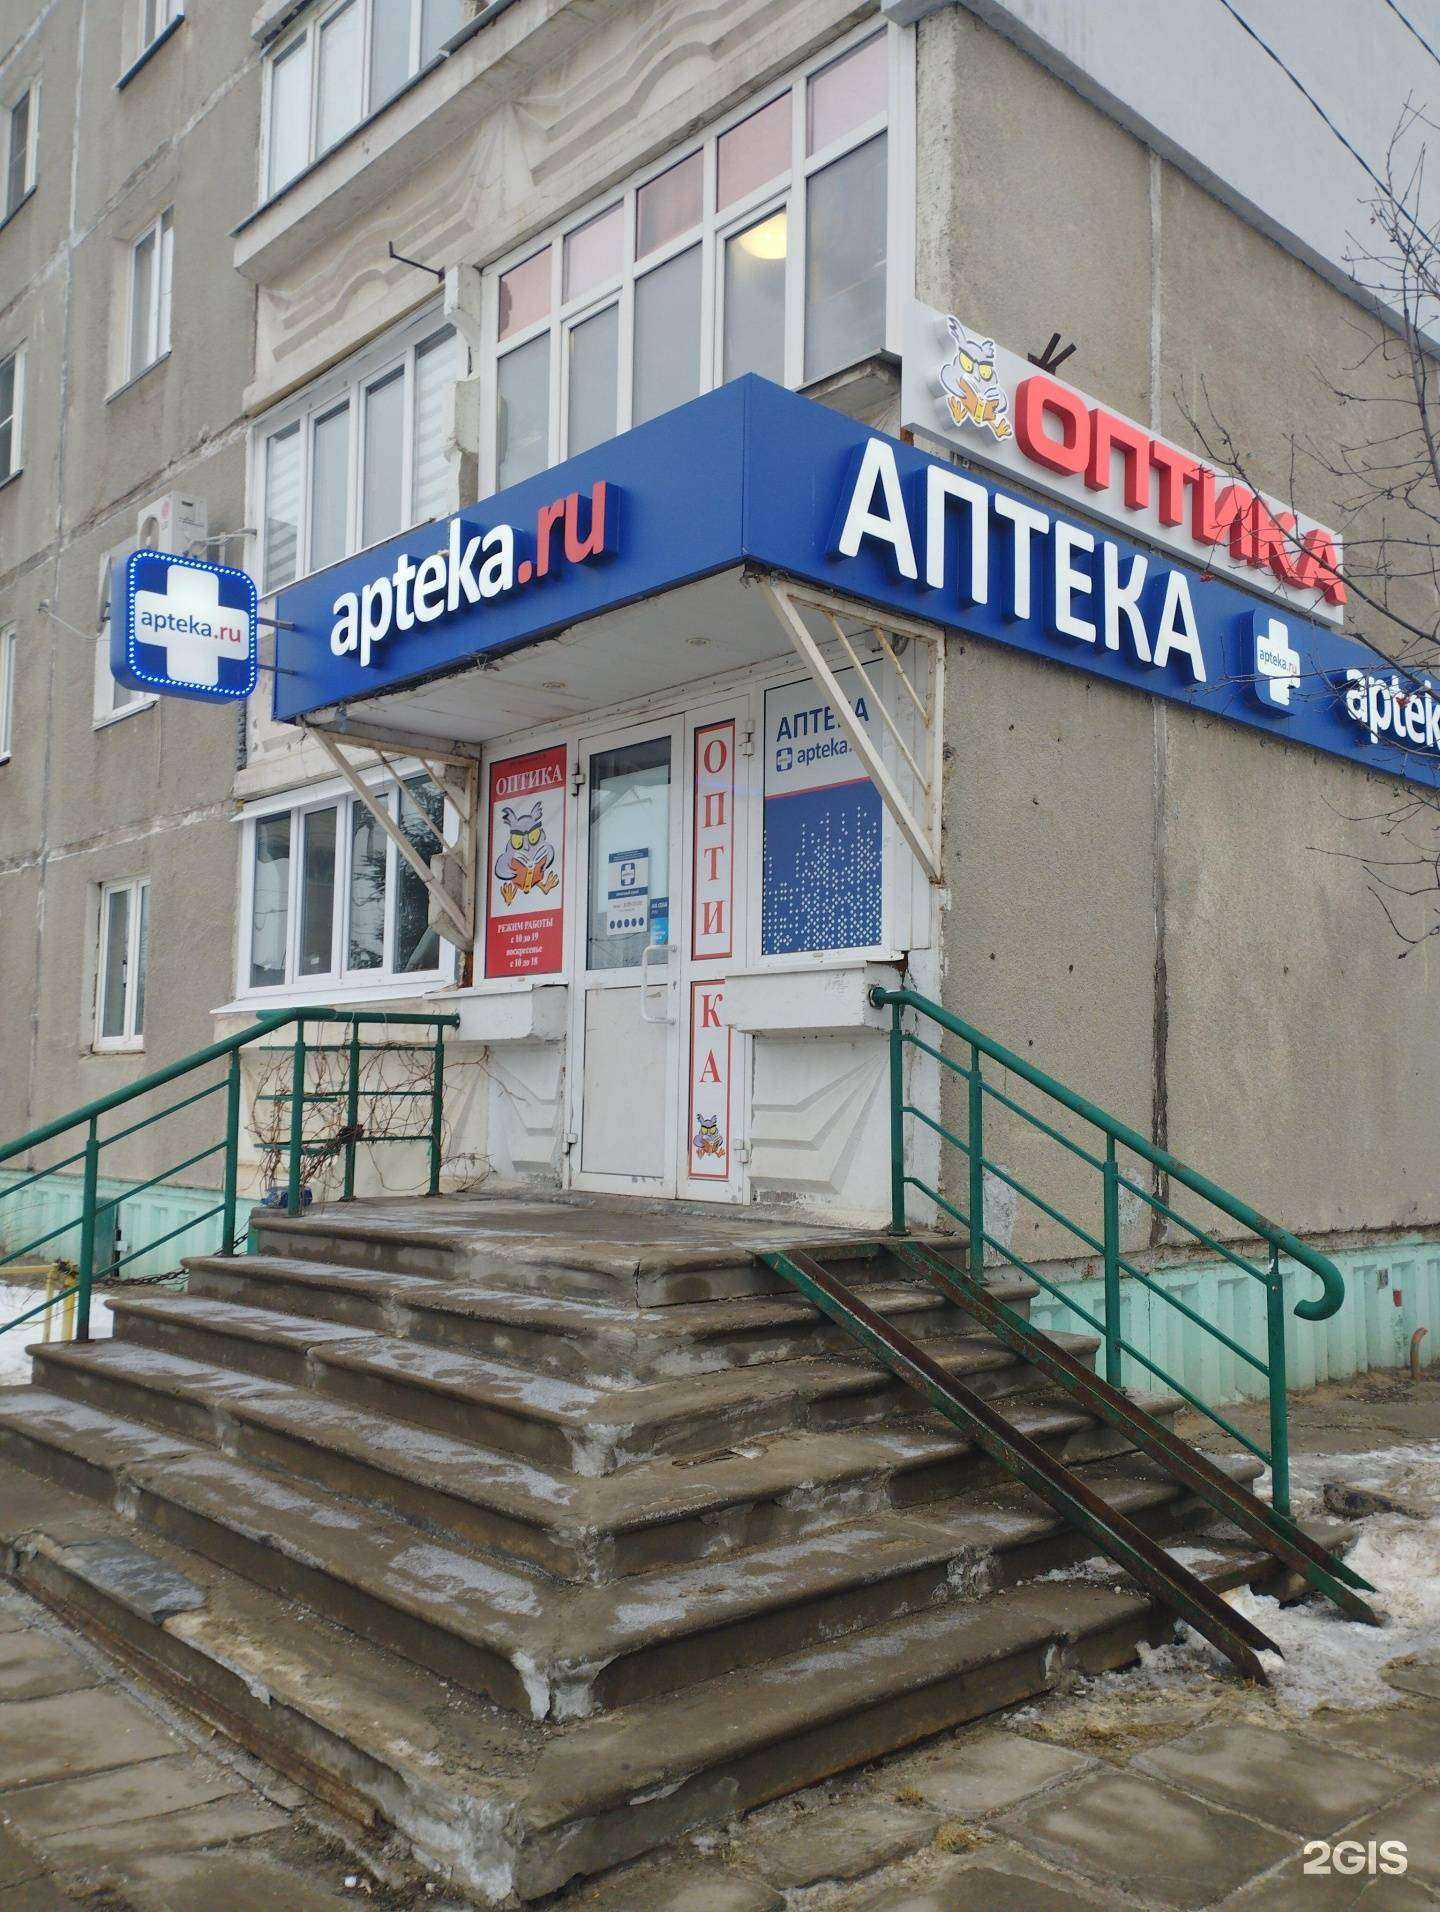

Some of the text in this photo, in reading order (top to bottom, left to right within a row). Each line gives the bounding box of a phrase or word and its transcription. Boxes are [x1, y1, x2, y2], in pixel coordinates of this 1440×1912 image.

[1015, 375, 1348, 606] ОПТИКА
[329, 480, 608, 668] apteka.ru
[838, 437, 1207, 683] АПТЕКА
[141, 610, 241, 643] apteka.ru
[1259, 649, 1297, 674] apteka.ru
[776, 697, 870, 742] АПТЕА
[797, 737, 853, 766] apteka.
[496, 763, 563, 795] ОПТИКА
[498, 918, 553, 933] РЕЖИМ РАБОТЫ
[516, 933, 523, 943] 10
